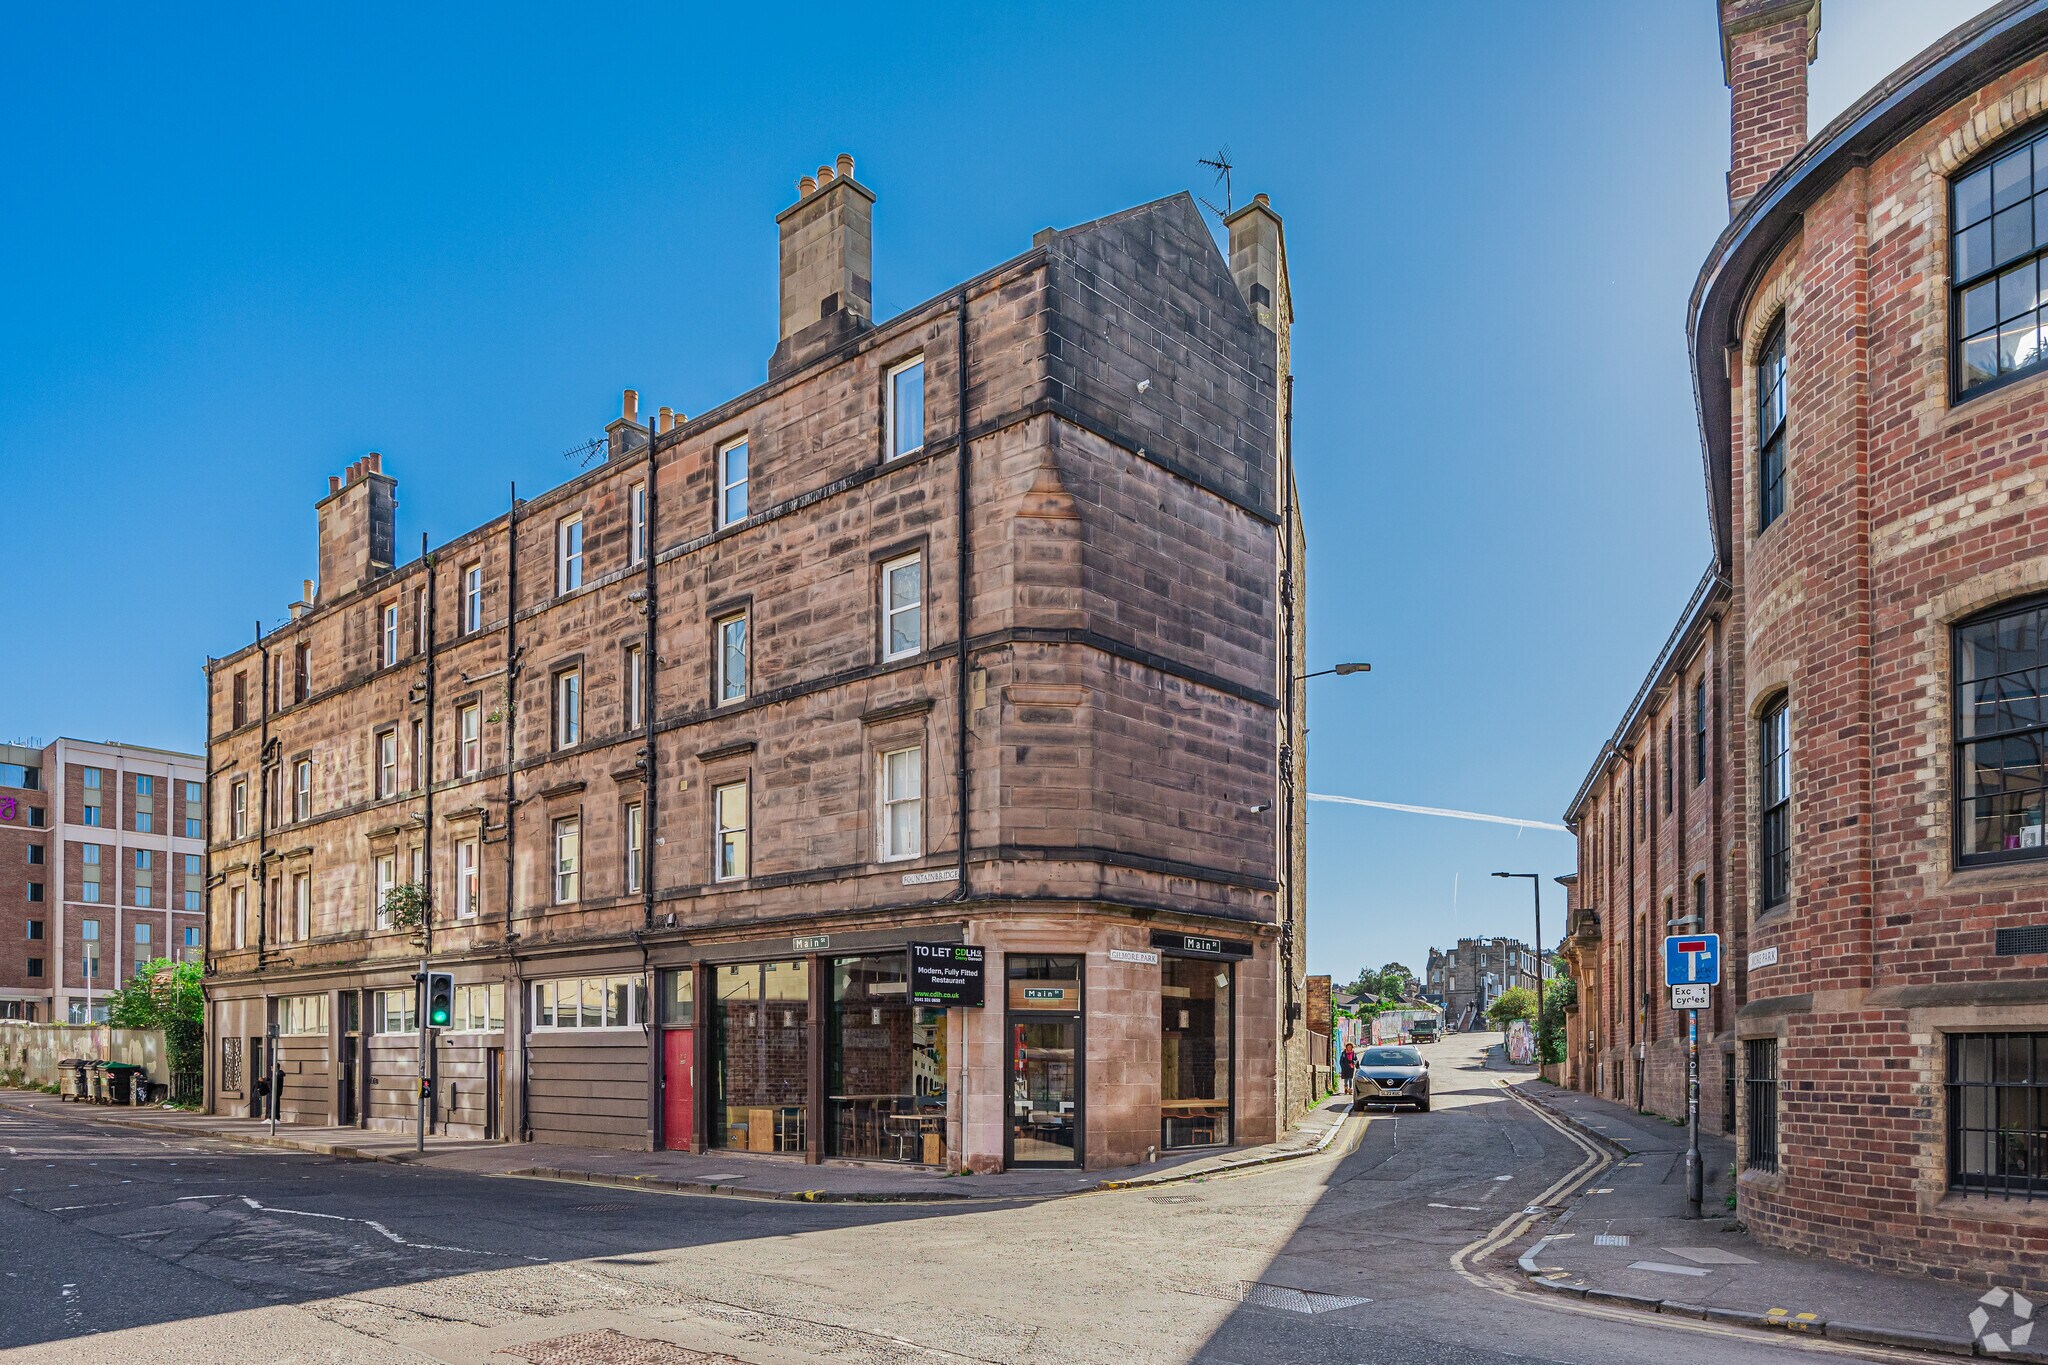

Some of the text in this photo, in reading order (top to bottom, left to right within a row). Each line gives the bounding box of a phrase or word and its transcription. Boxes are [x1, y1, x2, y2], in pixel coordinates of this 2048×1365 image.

[903, 870, 958, 884] FOUNTAINBRIDGE
[796, 939, 819, 948] Main
[1187, 939, 1211, 950] Main
[914, 945, 951, 957] TO LET
[1111, 951, 1156, 963] GILMORE PARK
[917, 966, 978, 977] Modern, Fully Fitted
[931, 976, 966, 985] Restaurant
[914, 991, 960, 999] www.cdlh.co.uk
[1675, 987, 1706, 996] Exct
